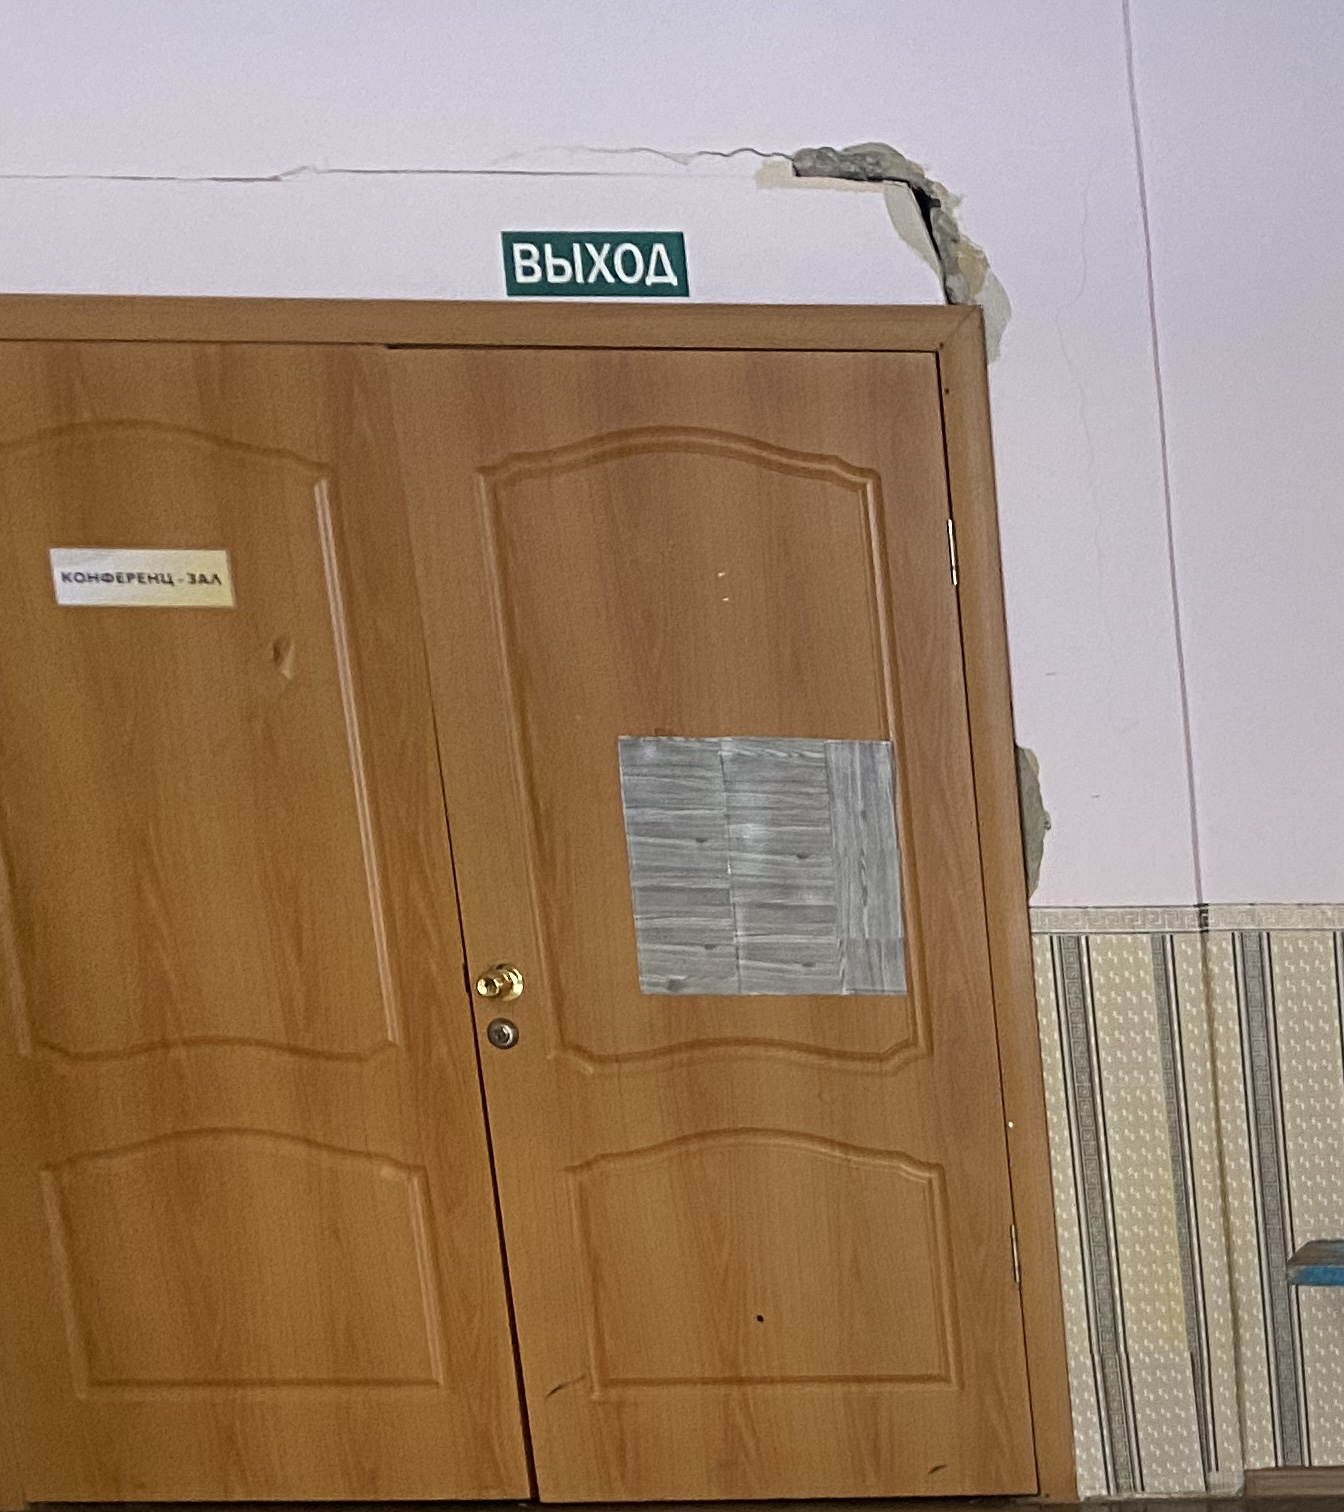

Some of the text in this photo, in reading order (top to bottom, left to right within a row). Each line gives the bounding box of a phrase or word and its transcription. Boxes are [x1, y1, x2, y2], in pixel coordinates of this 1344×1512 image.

[511, 242, 679, 287] ВЫХОД
[60, 571, 175, 586] КОНФЕРЕНЦ
[186, 572, 222, 585] ЗАЛ
